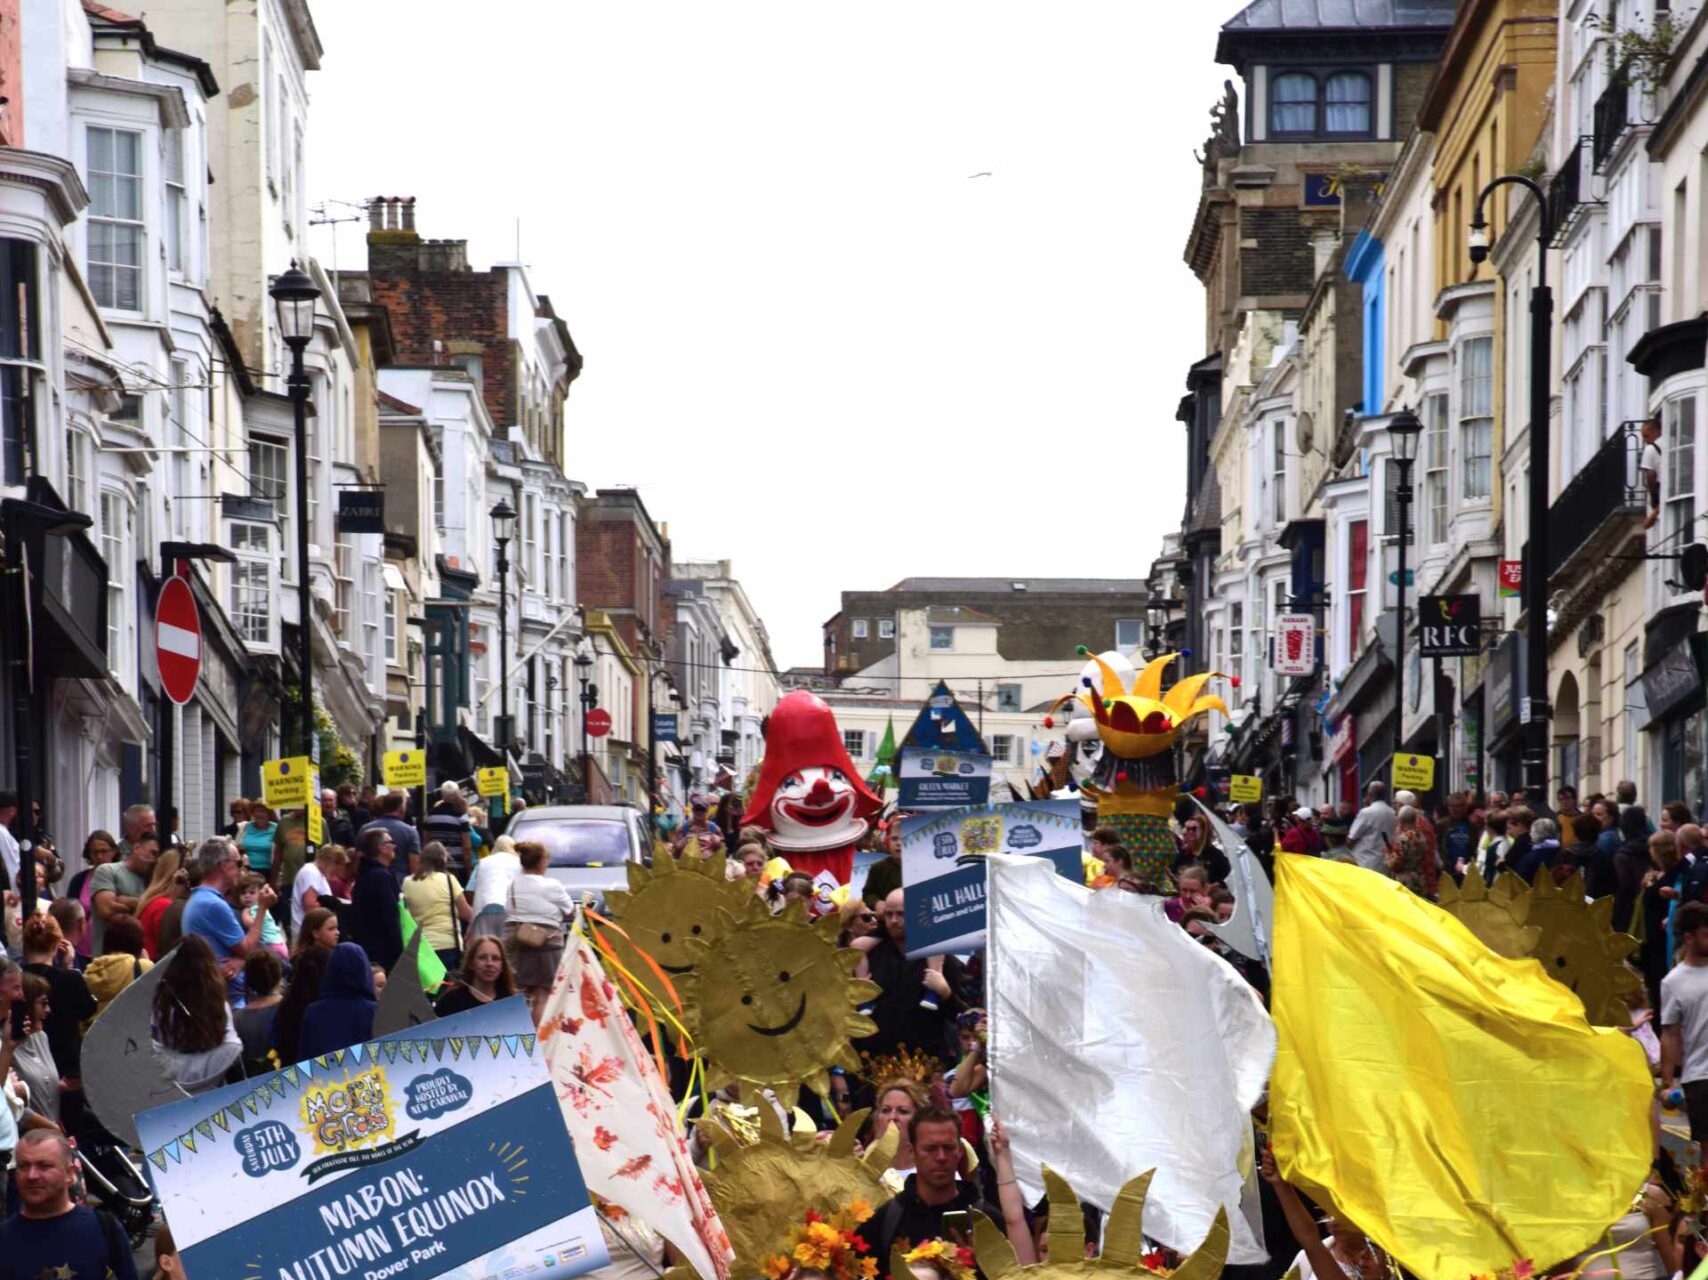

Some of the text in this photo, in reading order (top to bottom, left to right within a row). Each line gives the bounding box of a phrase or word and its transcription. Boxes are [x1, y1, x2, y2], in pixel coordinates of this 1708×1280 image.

[1504, 565, 1522, 575] JUS
[1423, 626, 1478, 647] RFC
[389, 763, 422, 771] WARNING
[1397, 765, 1429, 774] WARNING
[268, 775, 305, 787] WARNING
[931, 893, 954, 913] ALL
[956, 907, 969, 917] and
[414, 1083, 458, 1104] HOSTED BY
[415, 1075, 450, 1093] PROUDLY
[306, 1074, 384, 1124] Mardi
[410, 1090, 469, 1115] NEW CARNIVAL
[254, 1125, 287, 1148] 5TH
[319, 1103, 389, 1151] Gras
[242, 1134, 260, 1172] SATURDAY
[260, 1141, 297, 1169] JULY
[318, 1167, 429, 1236] MABON:
[391, 1171, 505, 1248] EQUINOX
[411, 1240, 448, 1265] Park
